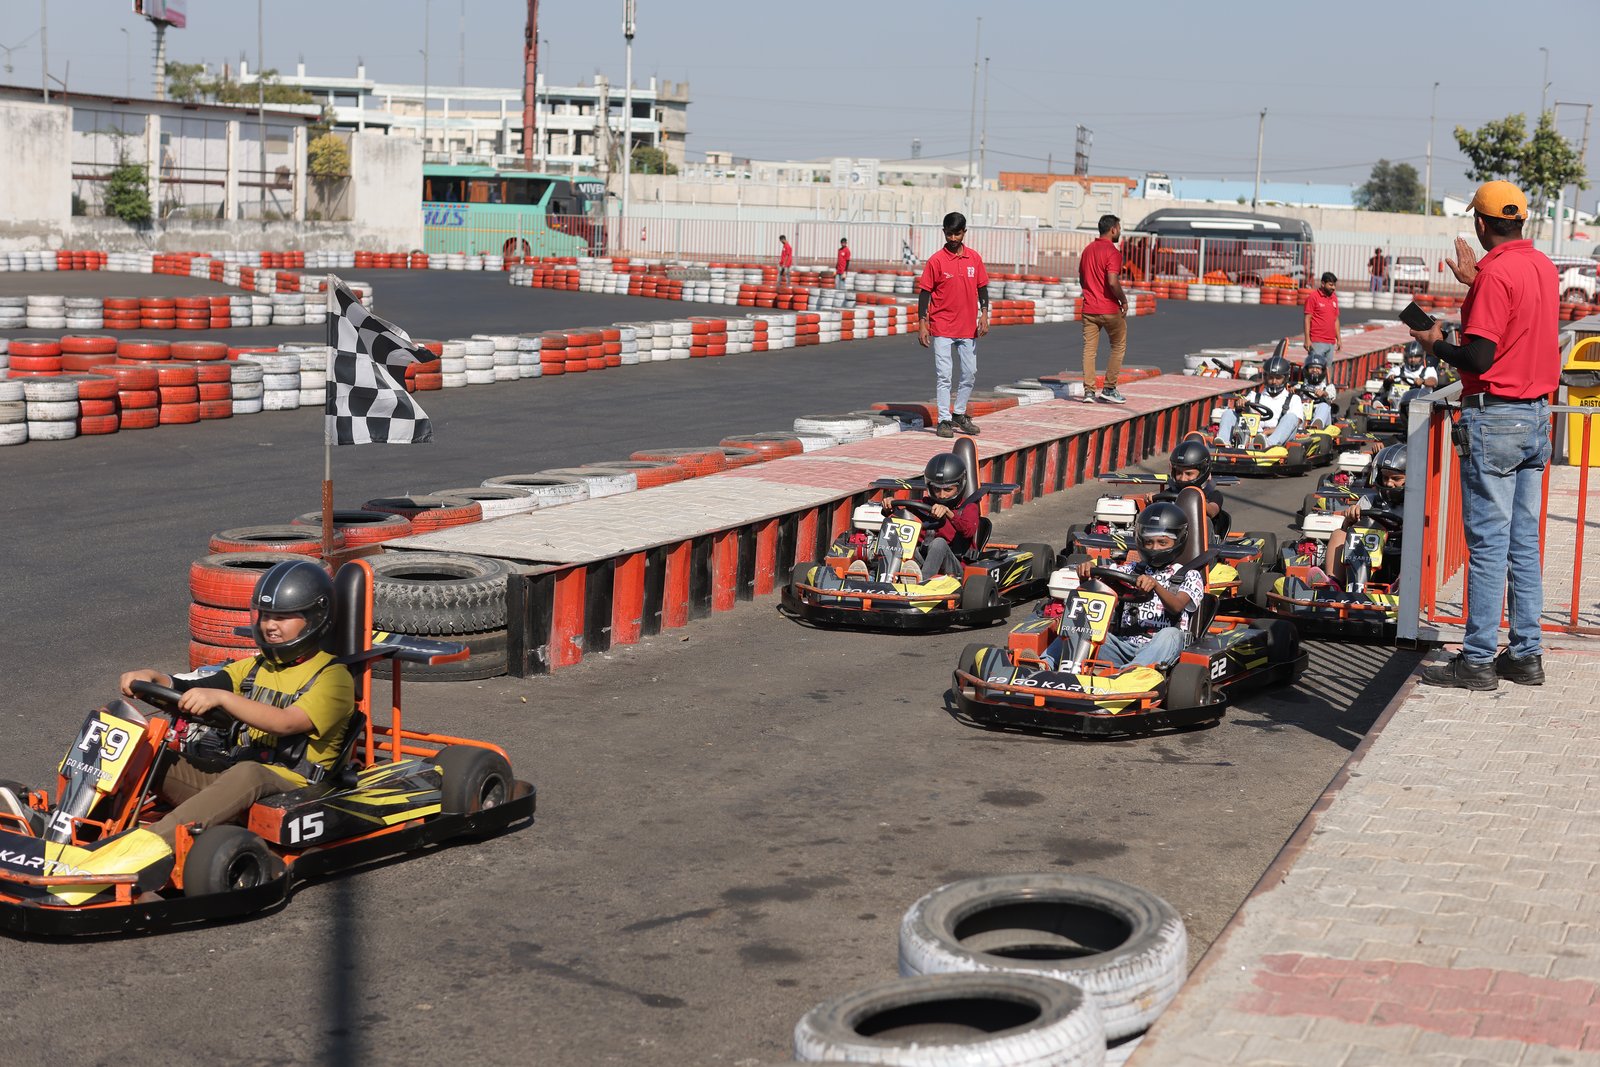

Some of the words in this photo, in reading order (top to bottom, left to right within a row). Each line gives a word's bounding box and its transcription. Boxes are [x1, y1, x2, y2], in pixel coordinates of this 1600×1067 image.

[1238, 416, 1256, 428] F9
[883, 522, 916, 543] F9
[1348, 532, 1380, 552] F9
[1067, 596, 1107, 622] F9
[1211, 657, 1227, 680] 22
[987, 676, 1008, 685] F9
[1013, 678, 1037, 687] GO
[78, 718, 131, 762] F9
[65, 757, 77, 768] GO
[76, 761, 113, 780] KARTING
[287, 811, 324, 844] 15
